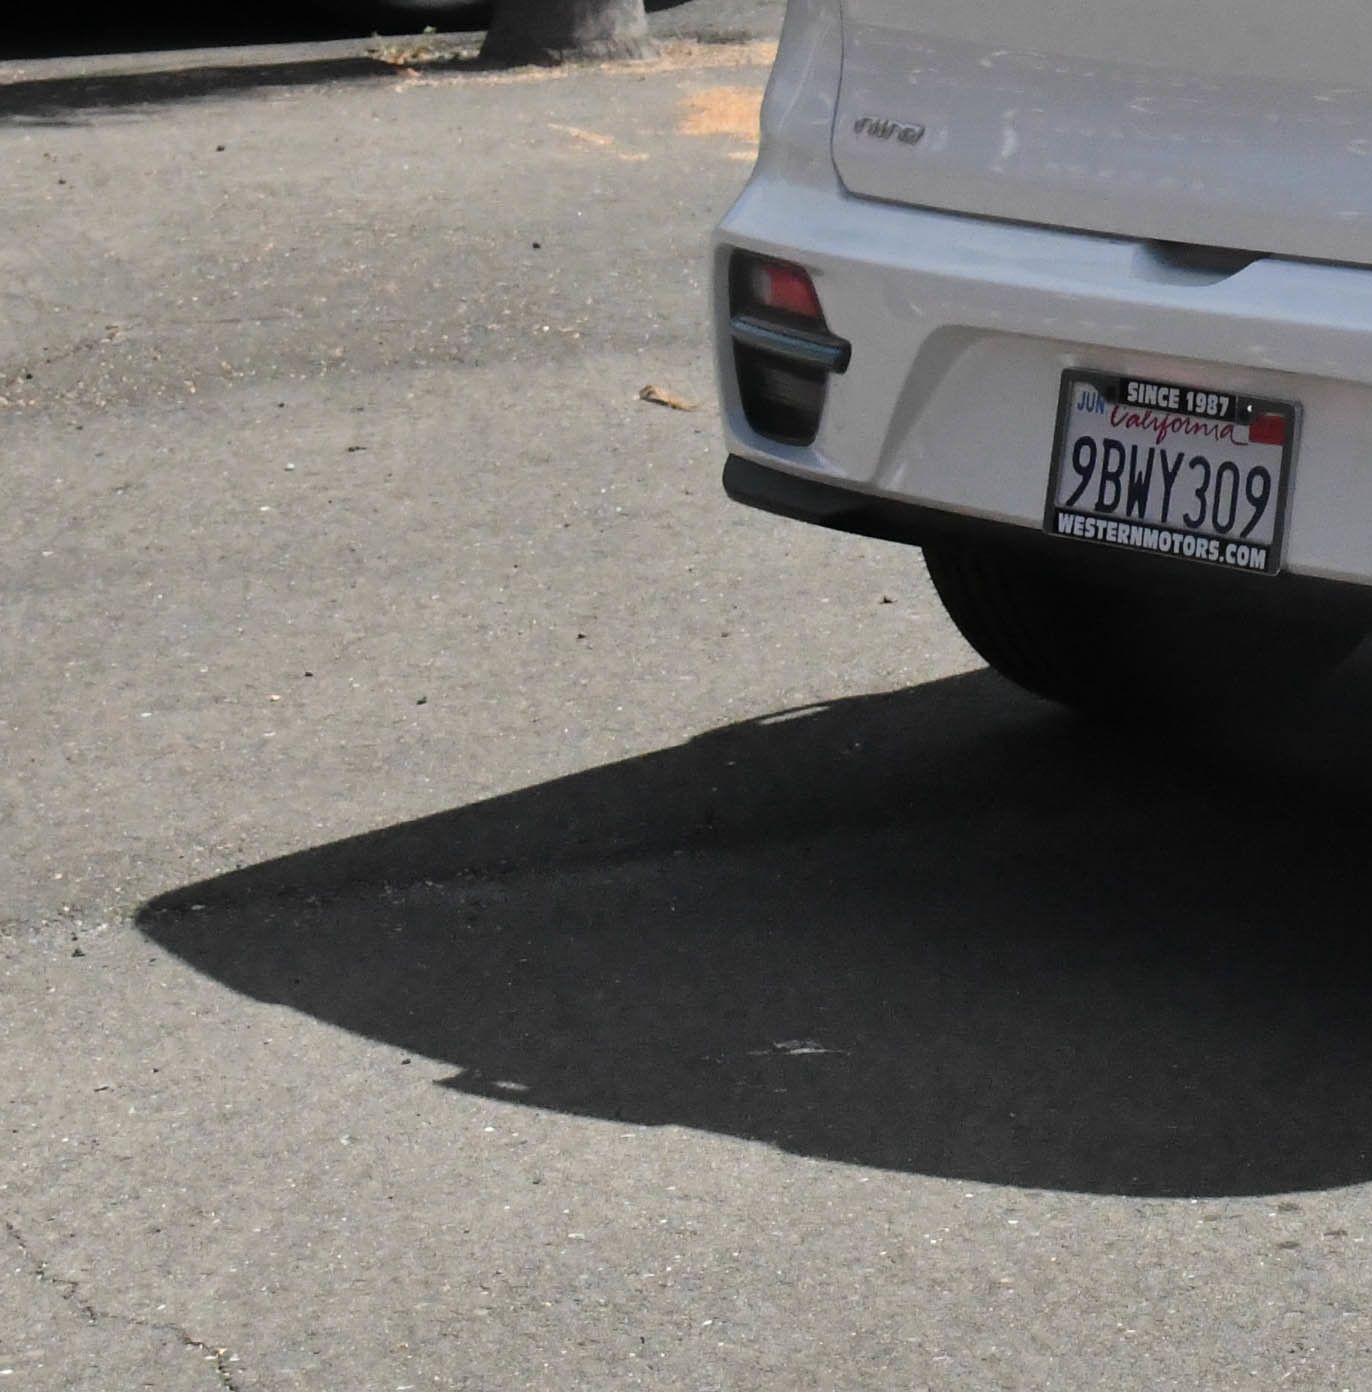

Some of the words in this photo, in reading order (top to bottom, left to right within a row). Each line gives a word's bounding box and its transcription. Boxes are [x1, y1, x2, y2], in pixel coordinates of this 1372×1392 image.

[1127, 382, 1180, 409] SINCE
[1186, 391, 1229, 417] 1987
[1110, 404, 1249, 446] California
[1066, 435, 1271, 538] 9BWY309
[1058, 512, 1267, 570] WESTERNMOTORS.COM
